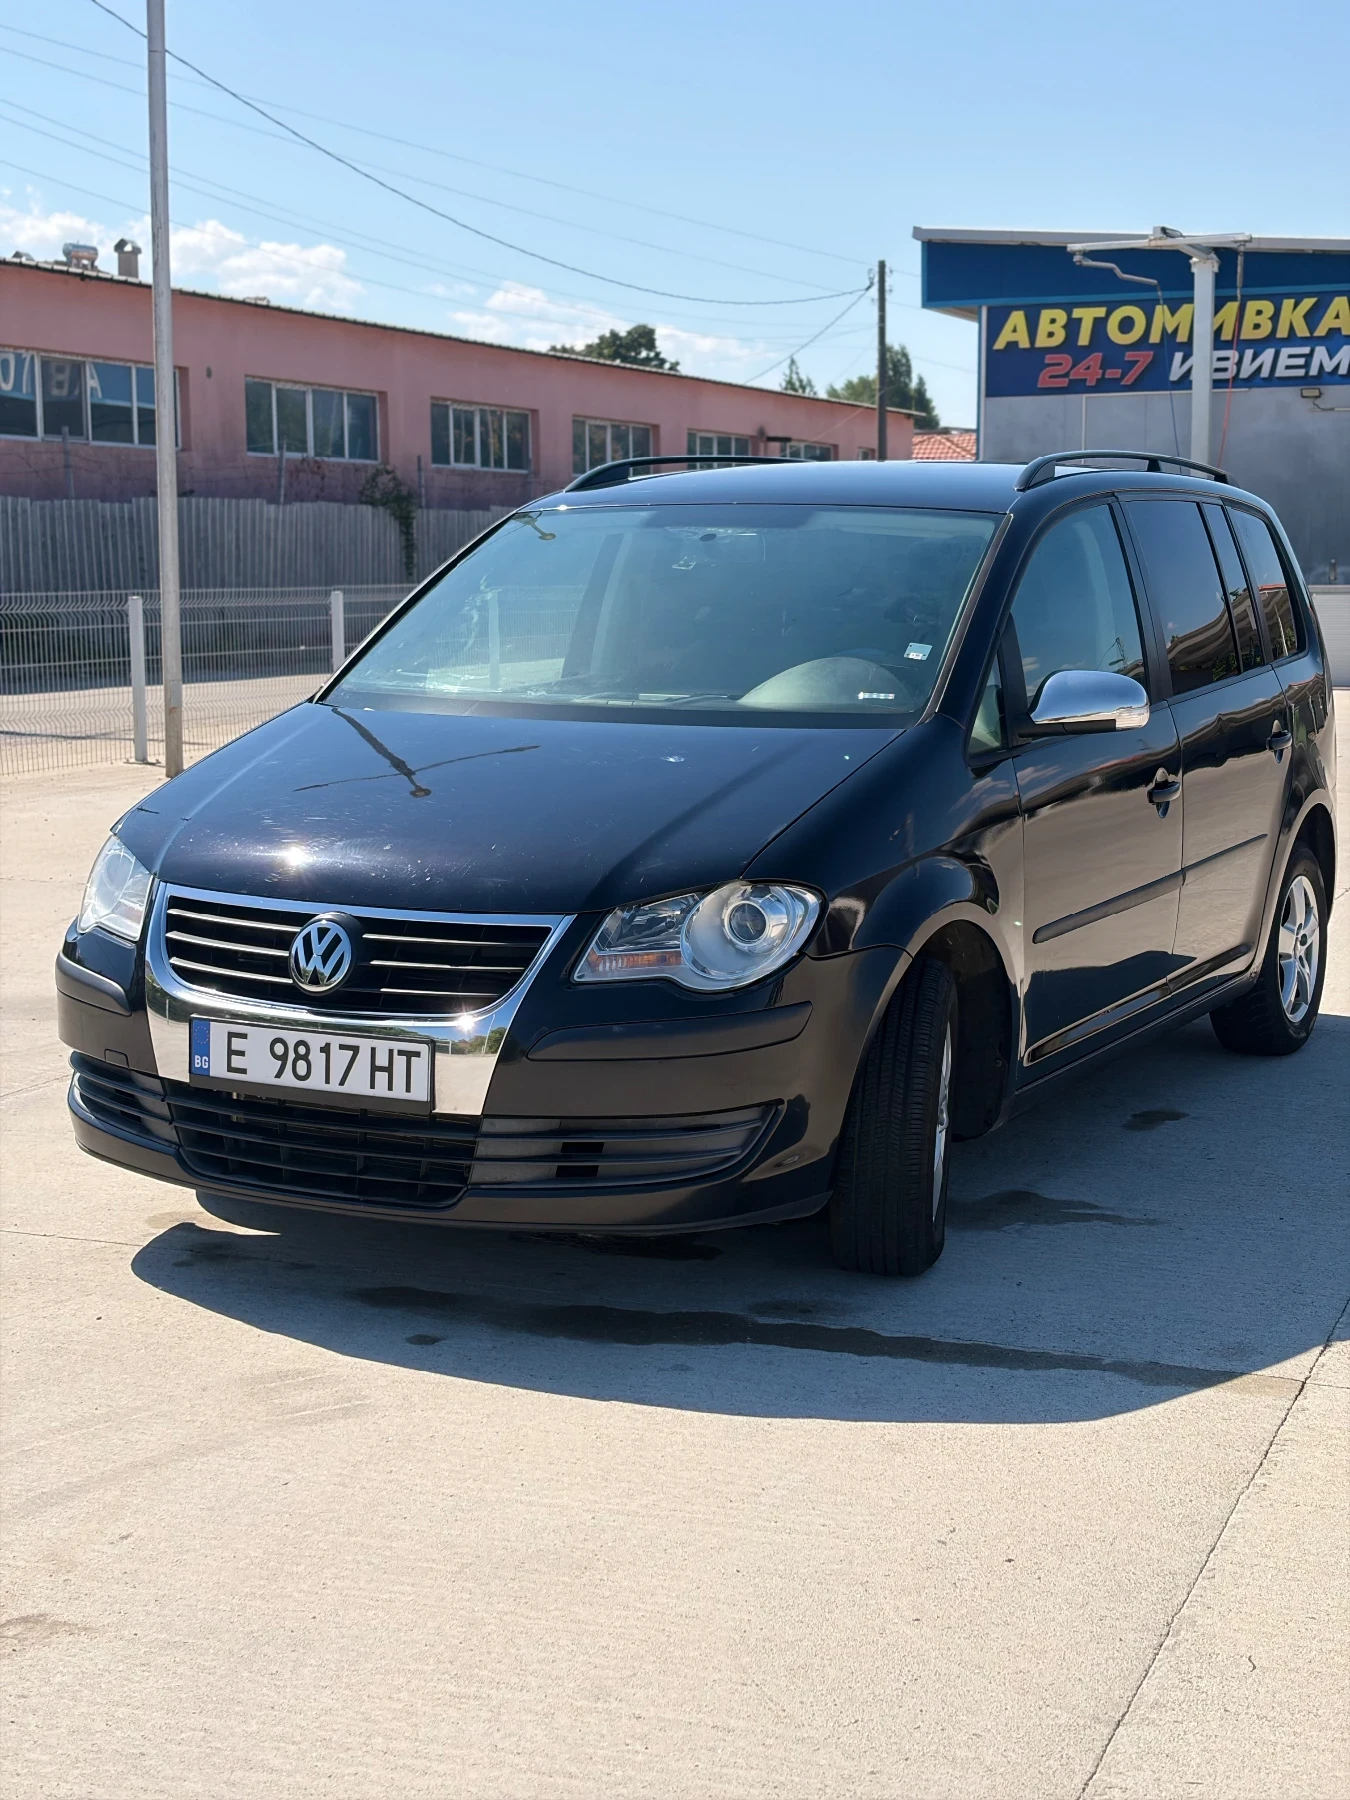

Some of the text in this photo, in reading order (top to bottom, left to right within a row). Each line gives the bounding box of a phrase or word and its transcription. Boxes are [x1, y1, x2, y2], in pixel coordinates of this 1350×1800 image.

[992, 296, 1350, 350] АВТОМИВКА
[1037, 351, 1154, 388] 24-7
[194, 1055, 209, 1068] BG
[226, 1031, 248, 1075] E
